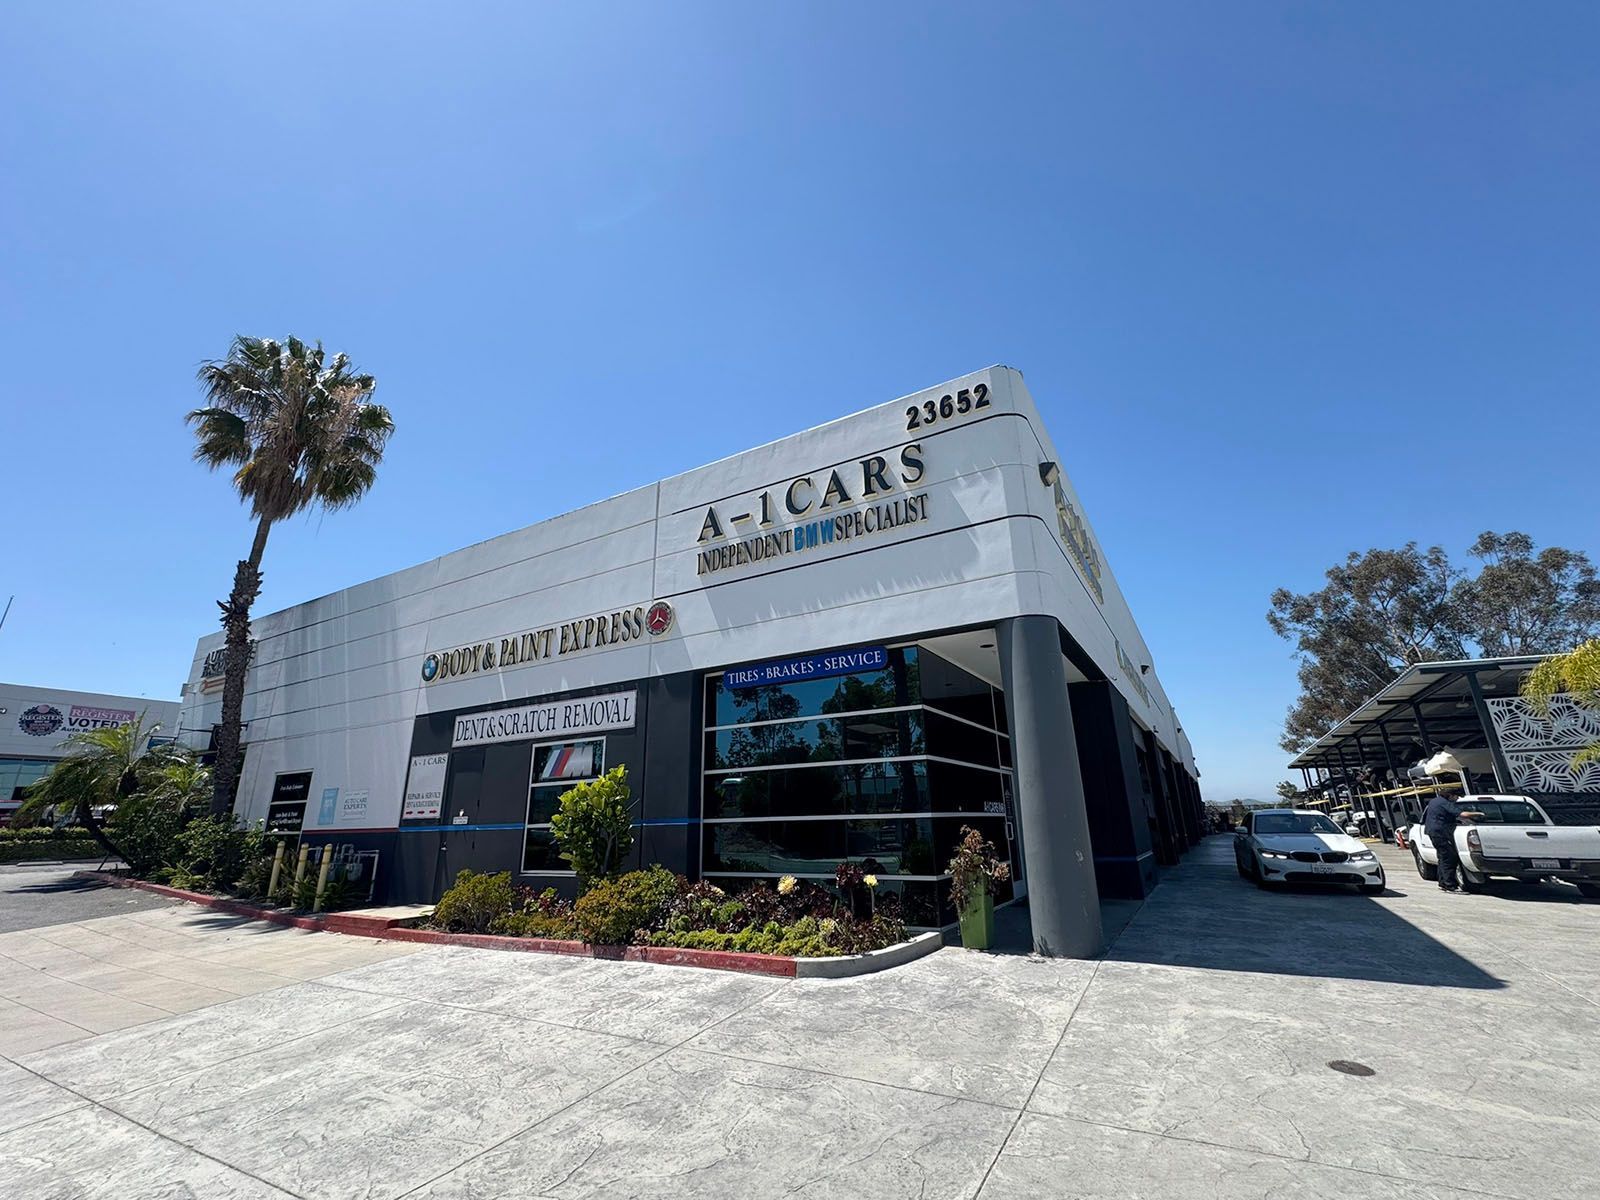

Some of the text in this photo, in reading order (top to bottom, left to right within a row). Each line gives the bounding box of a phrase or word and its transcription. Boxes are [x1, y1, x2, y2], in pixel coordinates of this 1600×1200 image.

[906, 383, 990, 431] 23652
[785, 444, 925, 515] CARS
[697, 493, 929, 576] INDEPENDENT BMW SPECIALIST
[439, 646, 486, 680] BODY
[482, 642, 496, 670] &
[498, 628, 555, 668] PAINT
[558, 607, 643, 656] EXPRESS
[728, 650, 882, 685] TIRES BRAKES SERVICE
[68, 717, 119, 729] VOTED
[71, 707, 131, 721] REGISTER
[562, 697, 632, 729] REMOVAL
[427, 756, 447, 766] CARS
